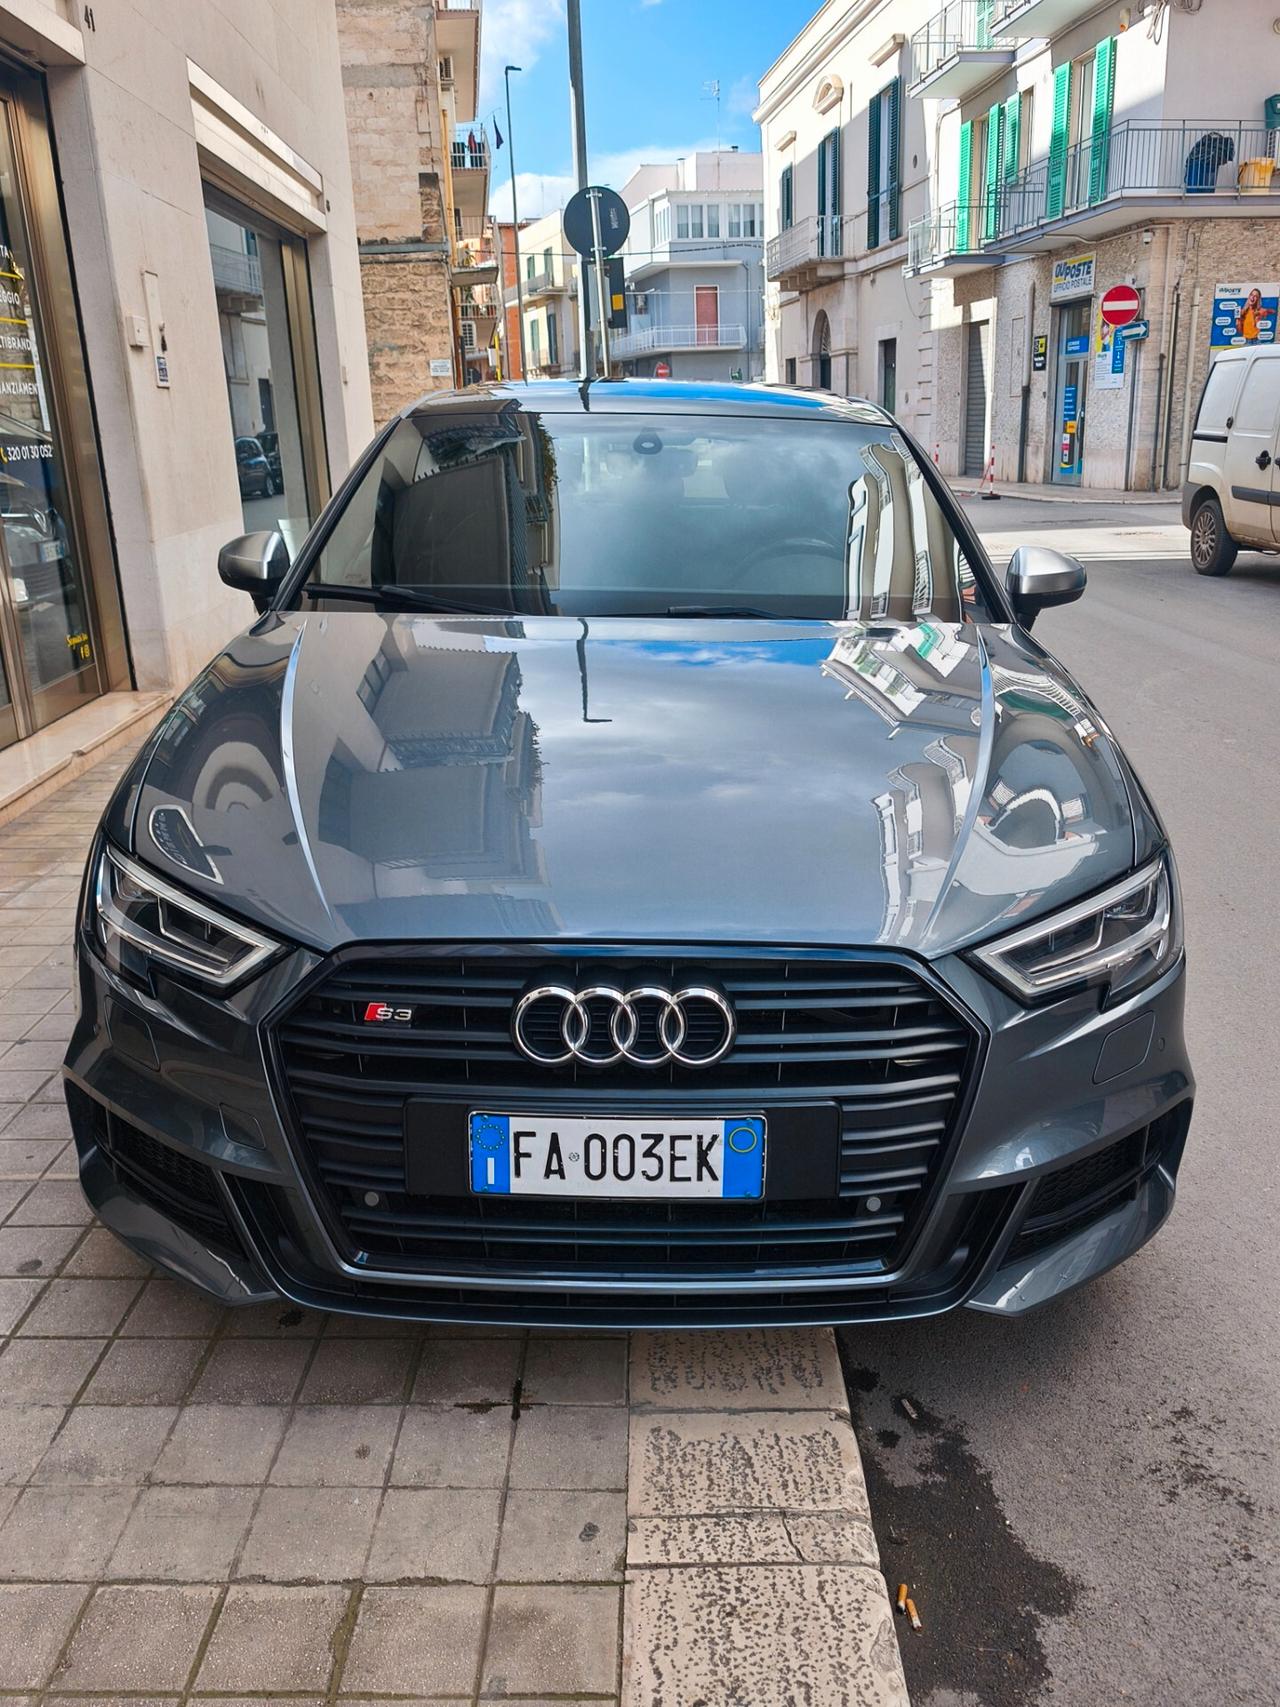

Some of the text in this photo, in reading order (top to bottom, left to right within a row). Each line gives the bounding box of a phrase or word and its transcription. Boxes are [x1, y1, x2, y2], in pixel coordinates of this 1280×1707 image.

[84, 4, 95, 32] 41
[0, 335, 32, 351] TIBRAND
[376, 1007, 412, 1020] S3
